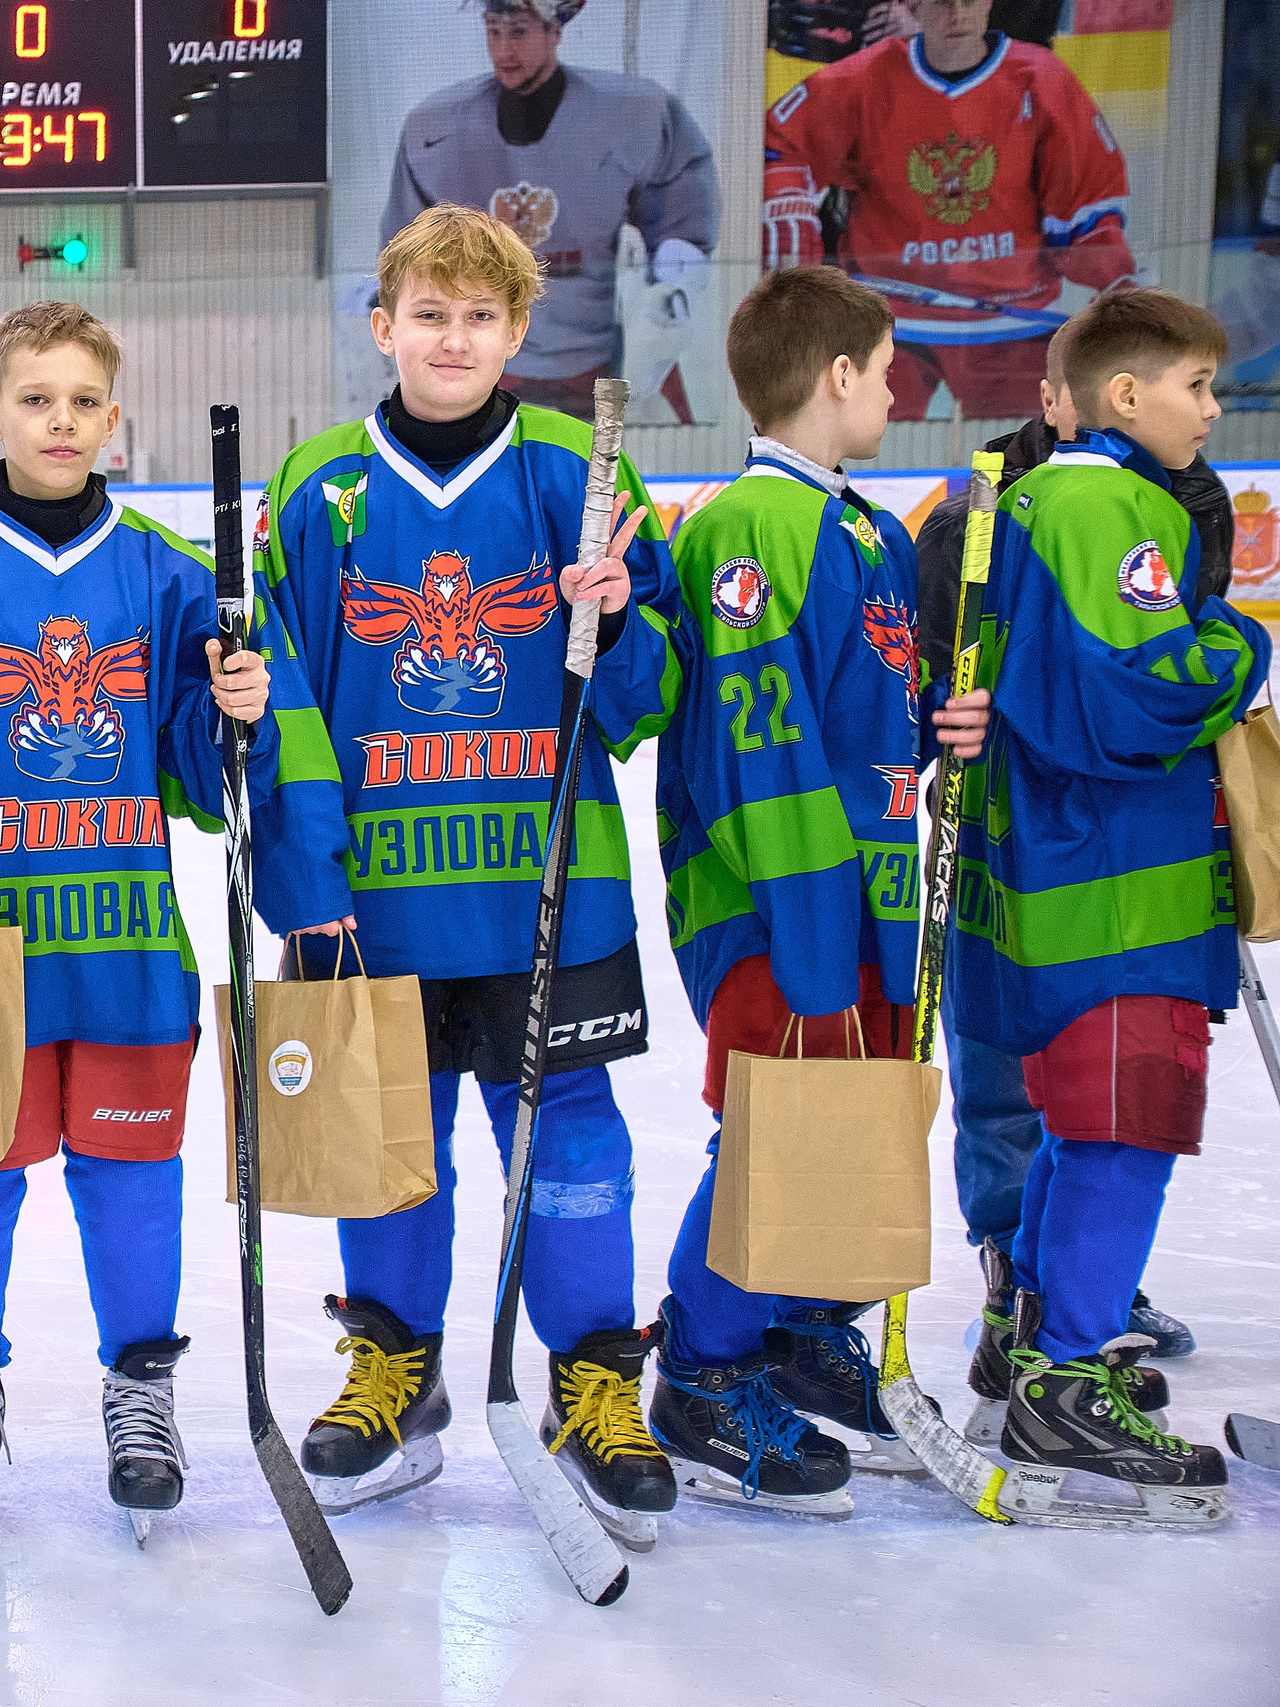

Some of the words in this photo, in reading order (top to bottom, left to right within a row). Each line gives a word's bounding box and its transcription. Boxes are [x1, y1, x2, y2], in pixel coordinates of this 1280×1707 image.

[16, 5, 47, 58] 0
[168, 38, 303, 66] УДАЛЕНИЯ
[901, 231, 1016, 265] РОССИЯ
[718, 662, 803, 754] 22
[353, 728, 560, 791] СОКОЛ
[350, 812, 578, 878] УЗЛОВА
[931, 816, 960, 926] TACKS
[547, 1008, 642, 1047] CCM
[1019, 1470, 1061, 1485] Reebok
